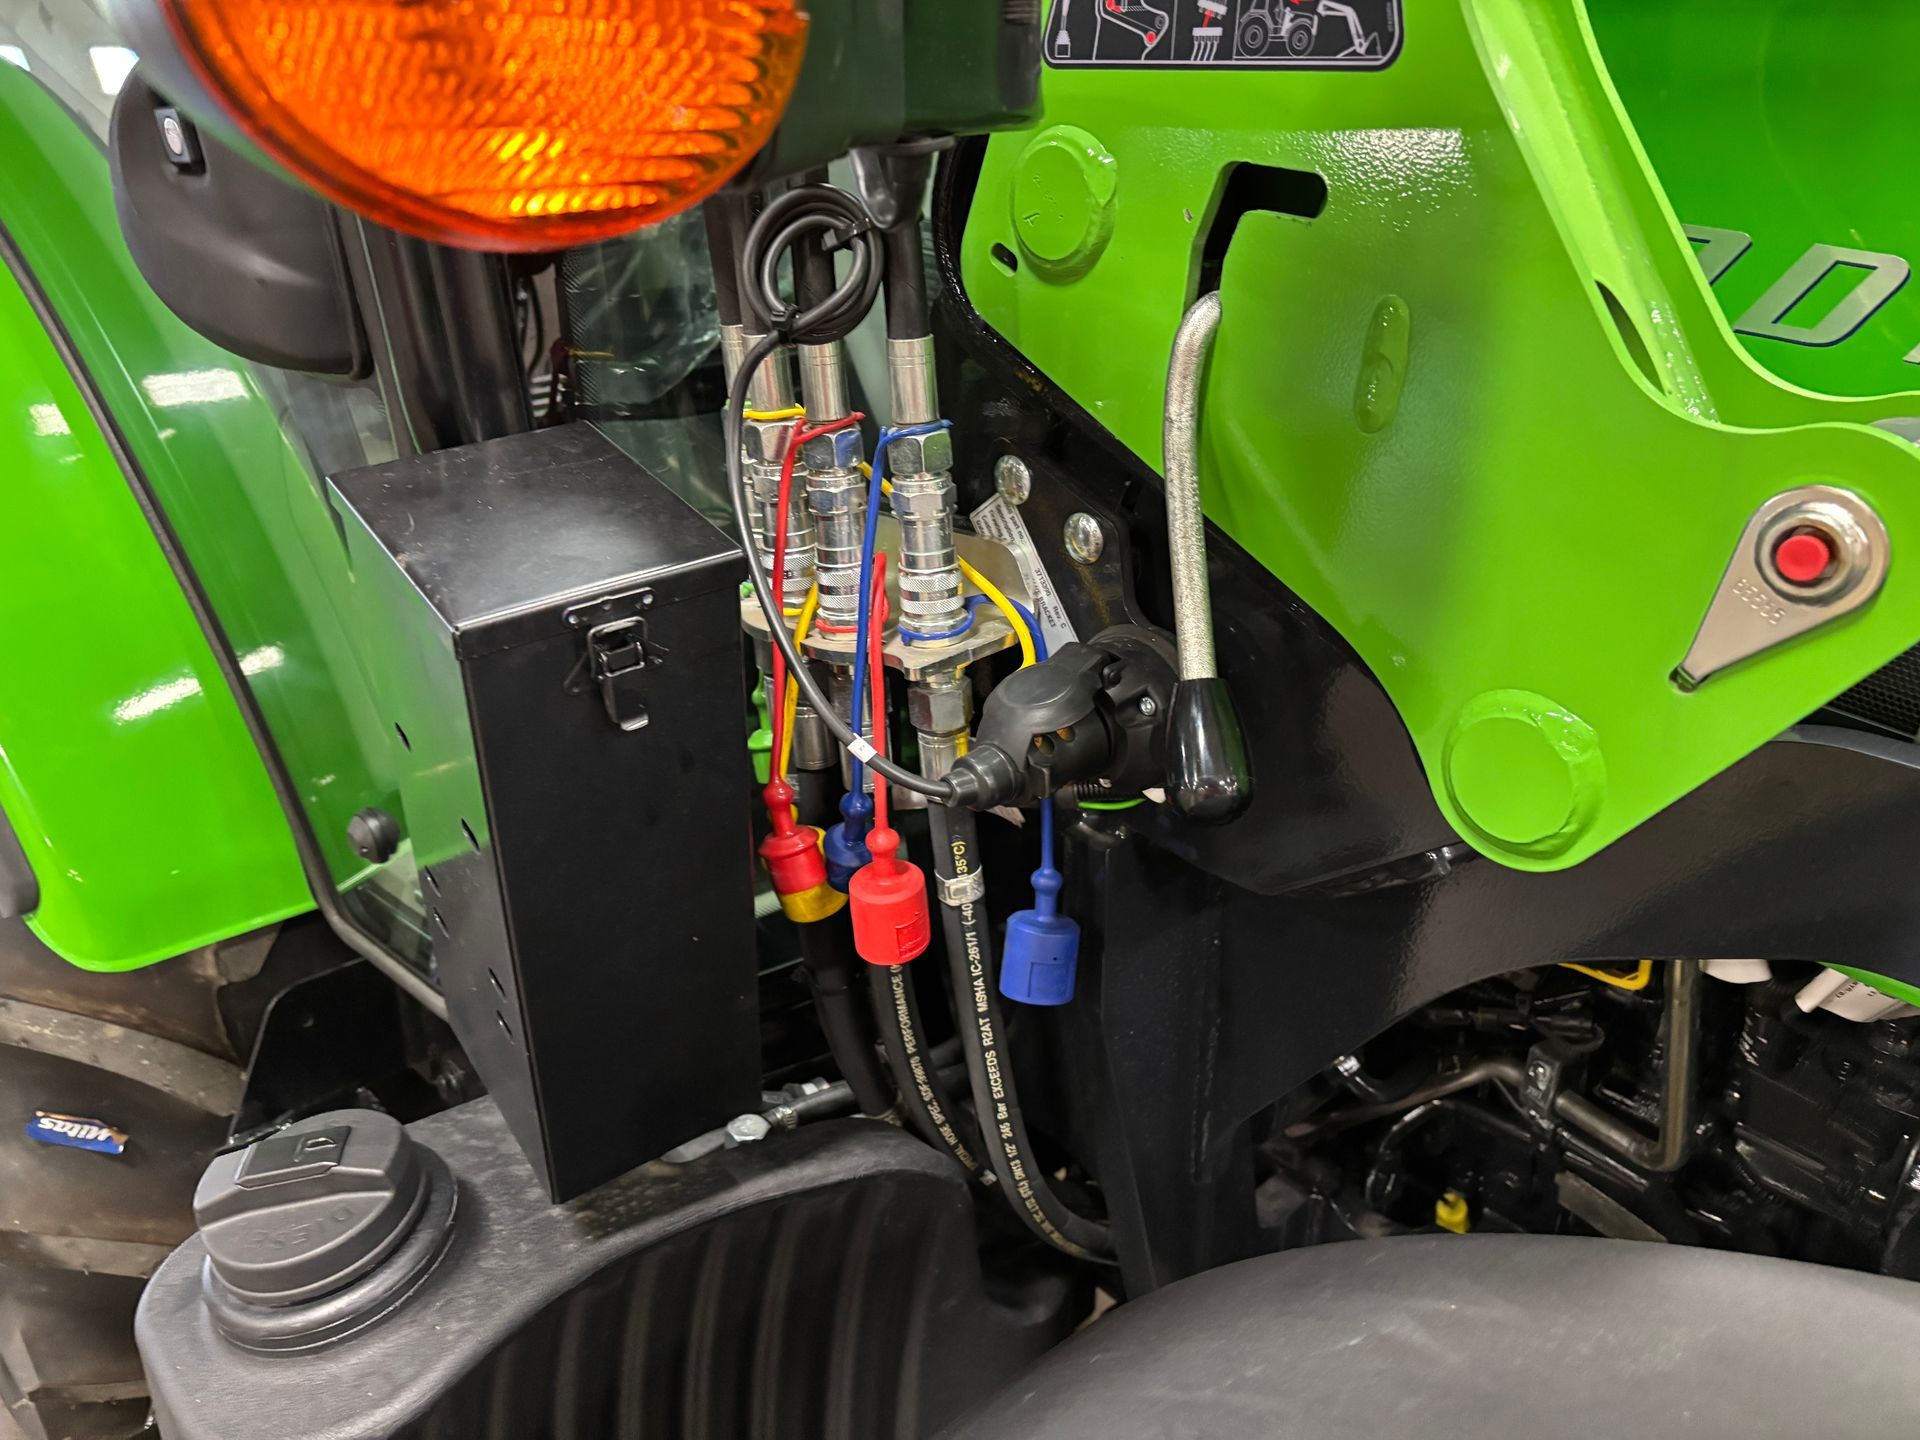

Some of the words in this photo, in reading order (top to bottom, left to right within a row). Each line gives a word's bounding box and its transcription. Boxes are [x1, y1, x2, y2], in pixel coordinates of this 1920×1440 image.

[1060, 622, 1067, 630] C
[965, 931, 983, 977] IC-261/1
[973, 977, 989, 1013] MSHA
[891, 973, 917, 1054] PERFORMANCE
[979, 1018, 994, 1047] R2AT
[984, 1049, 1004, 1099] EXCEEDS
[997, 1102, 1008, 1120] Bar
[939, 1123, 958, 1146] HOSE
